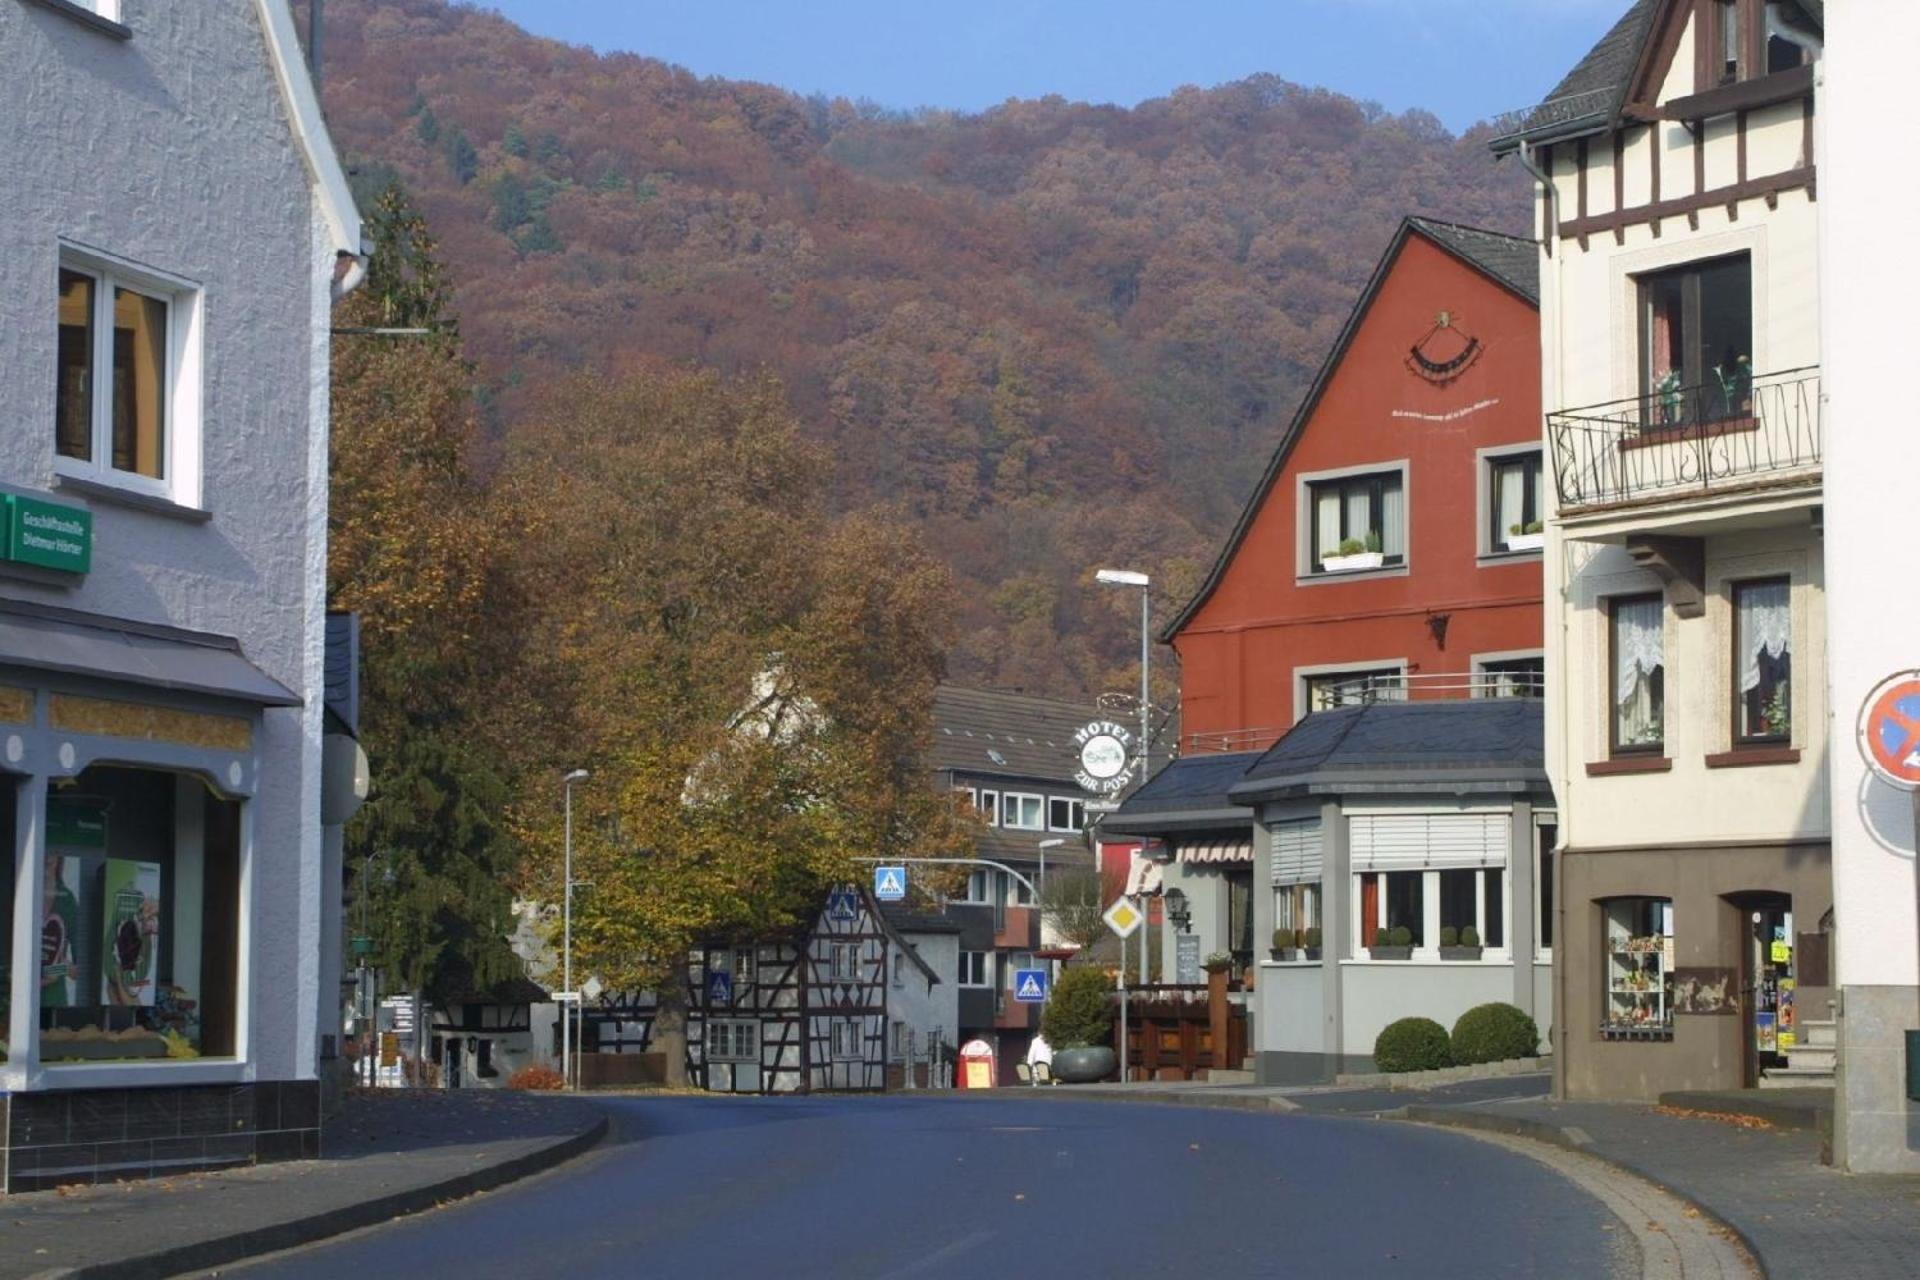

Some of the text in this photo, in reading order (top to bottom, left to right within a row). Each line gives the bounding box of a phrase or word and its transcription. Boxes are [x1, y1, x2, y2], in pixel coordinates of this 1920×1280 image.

[23, 532, 56, 550] Dietmar
[1075, 722, 1130, 744] HOTEL
[1074, 768, 1133, 792] ZUR POST
